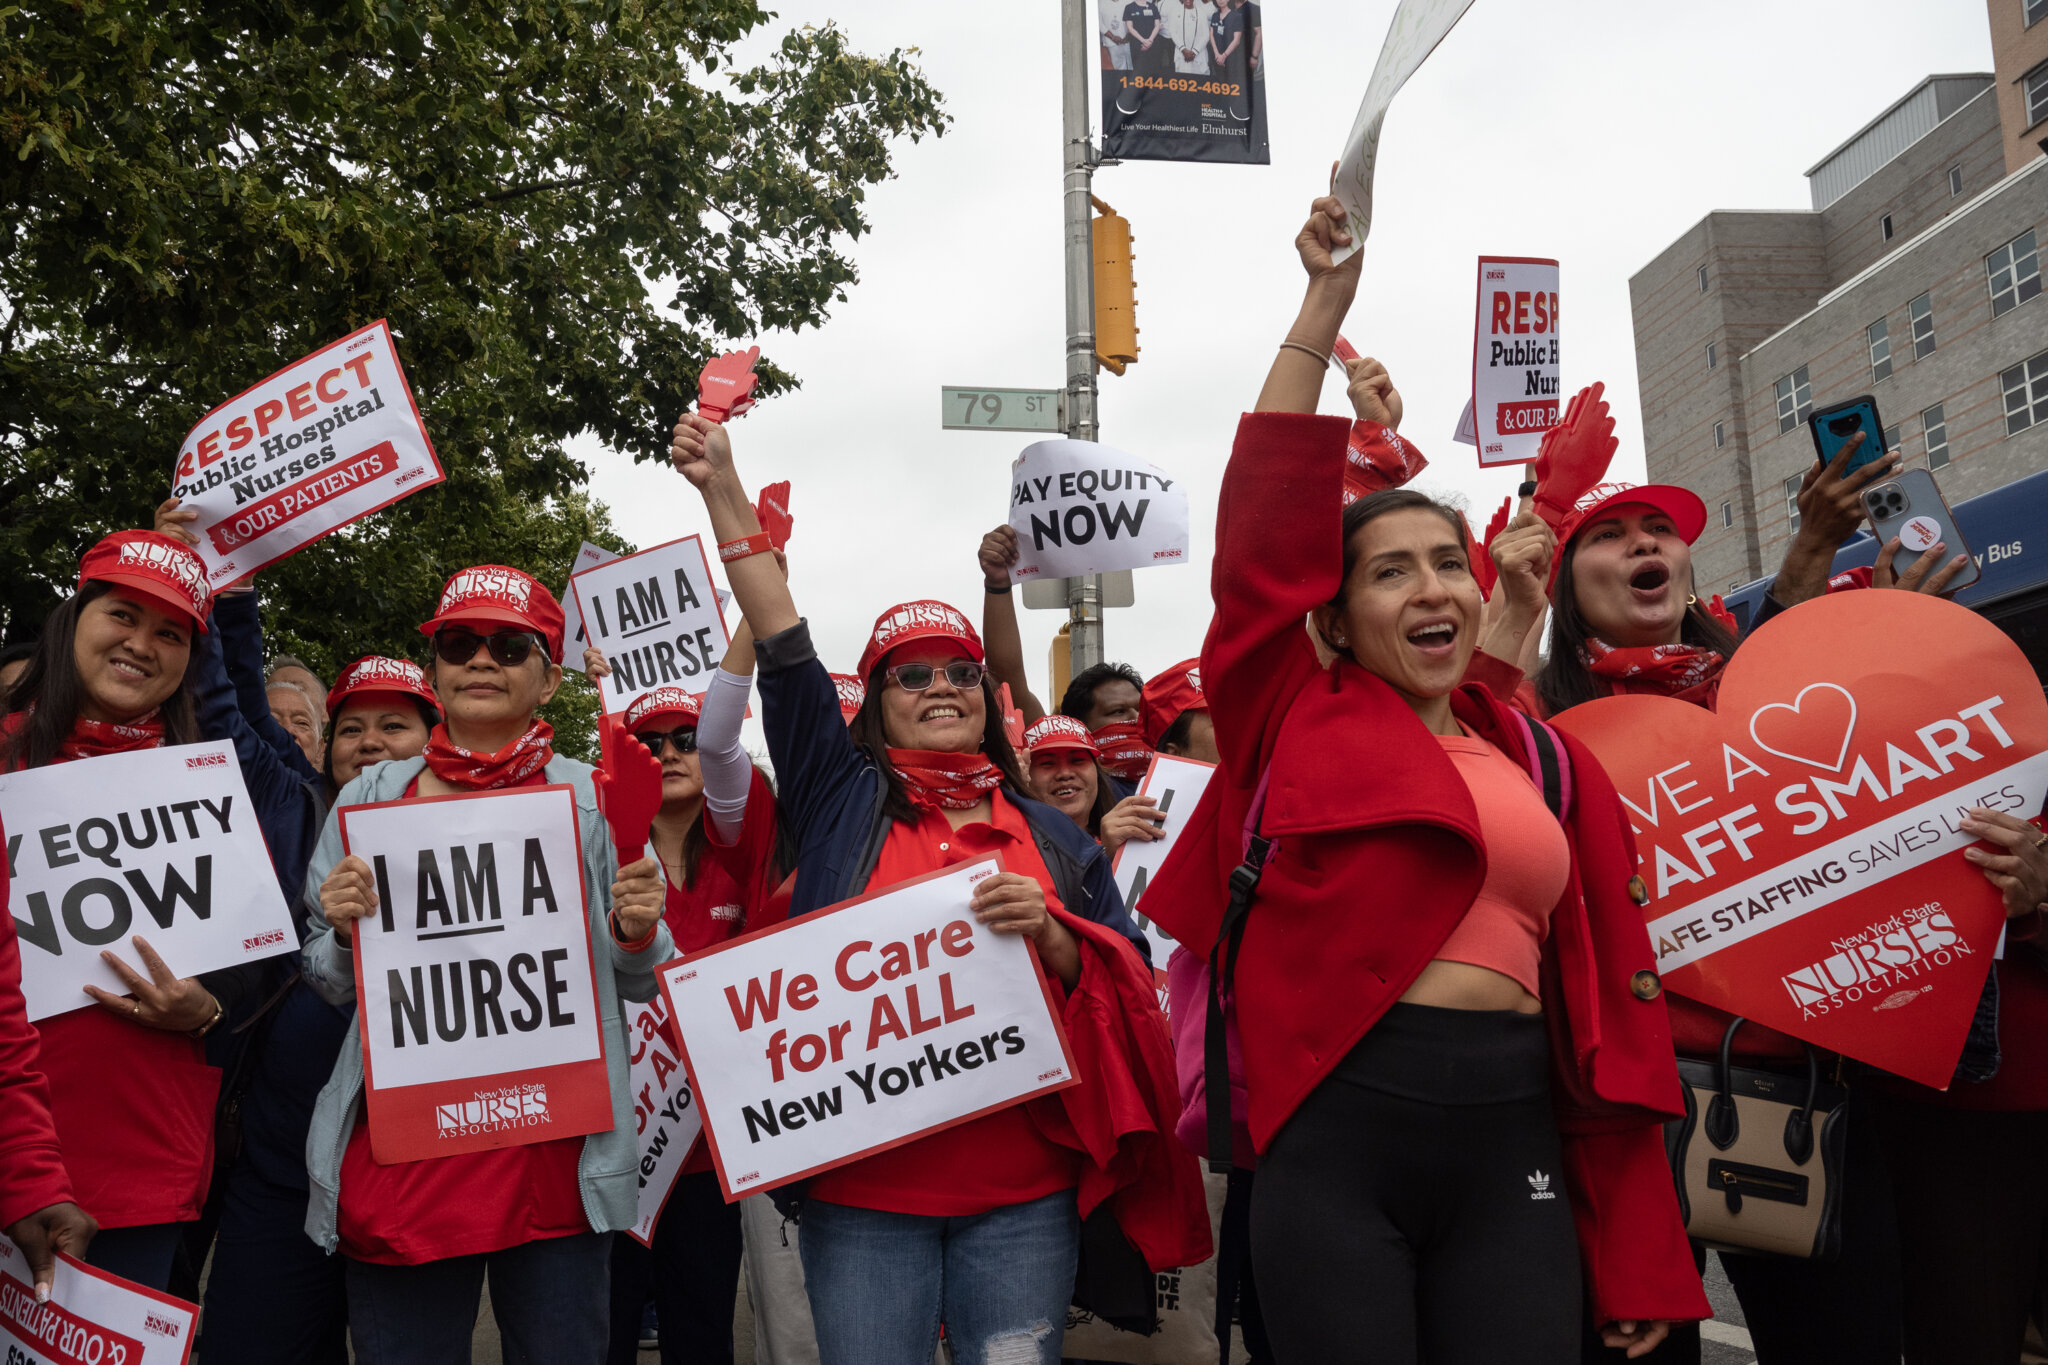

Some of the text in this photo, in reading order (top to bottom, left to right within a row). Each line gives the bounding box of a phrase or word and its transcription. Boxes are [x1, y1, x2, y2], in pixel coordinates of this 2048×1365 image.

[1119, 76, 1241, 96] 1-844-692-4692
[1135, 123, 1151, 131] Your
[1152, 124, 1186, 133] Healthiest
[1201, 124, 1247, 136] Elmhurst
[1490, 290, 1559, 335] RESP
[1490, 339, 1546, 367] Public
[174, 351, 375, 487] RESPECT
[957, 393, 1046, 425] 79 ST
[1504, 407, 1515, 429] &
[1516, 407, 1546, 428] OUR
[173, 388, 385, 503] Public Hospital
[220, 453, 384, 545] & OUR PATIENTS
[229, 444, 337, 505] Nurses
[1012, 469, 1174, 509] PAY EQUITY
[1031, 499, 1150, 551] NOW
[466, 568, 488, 576] New
[489, 567, 510, 578] York
[1988, 540, 2023, 564] Bus
[592, 568, 701, 638] I AM A
[609, 626, 720, 694] NURSE
[185, 754, 227, 768] NURSES
[1722, 742, 1771, 794] A
[1774, 695, 2015, 836] SMART
[39, 796, 233, 869] EQUITY
[373, 838, 559, 933] I AM A
[1711, 861, 1848, 932] STAFFING
[1847, 819, 1941, 874] SAVES
[242, 932, 285, 949] NURSES
[1830, 901, 1943, 954] New York State
[723, 919, 976, 1033] We Care
[1781, 911, 1963, 1009] NURSES
[1802, 941, 1972, 1022] ASSOCIATION
[387, 948, 576, 1049] NURSE
[1920, 984, 1933, 993] 120
[765, 1019, 852, 1083] for
[866, 972, 976, 1052] ALL
[436, 1090, 548, 1130] NURSES
[474, 1083, 546, 1101] New York State
[741, 1085, 843, 1144] New
[845, 1025, 1026, 1105] Yorkers
[438, 1113, 552, 1139] ASSOCIATION
[1531, 1191, 1556, 1200] adidas
[59, 1320, 105, 1365] OUR
